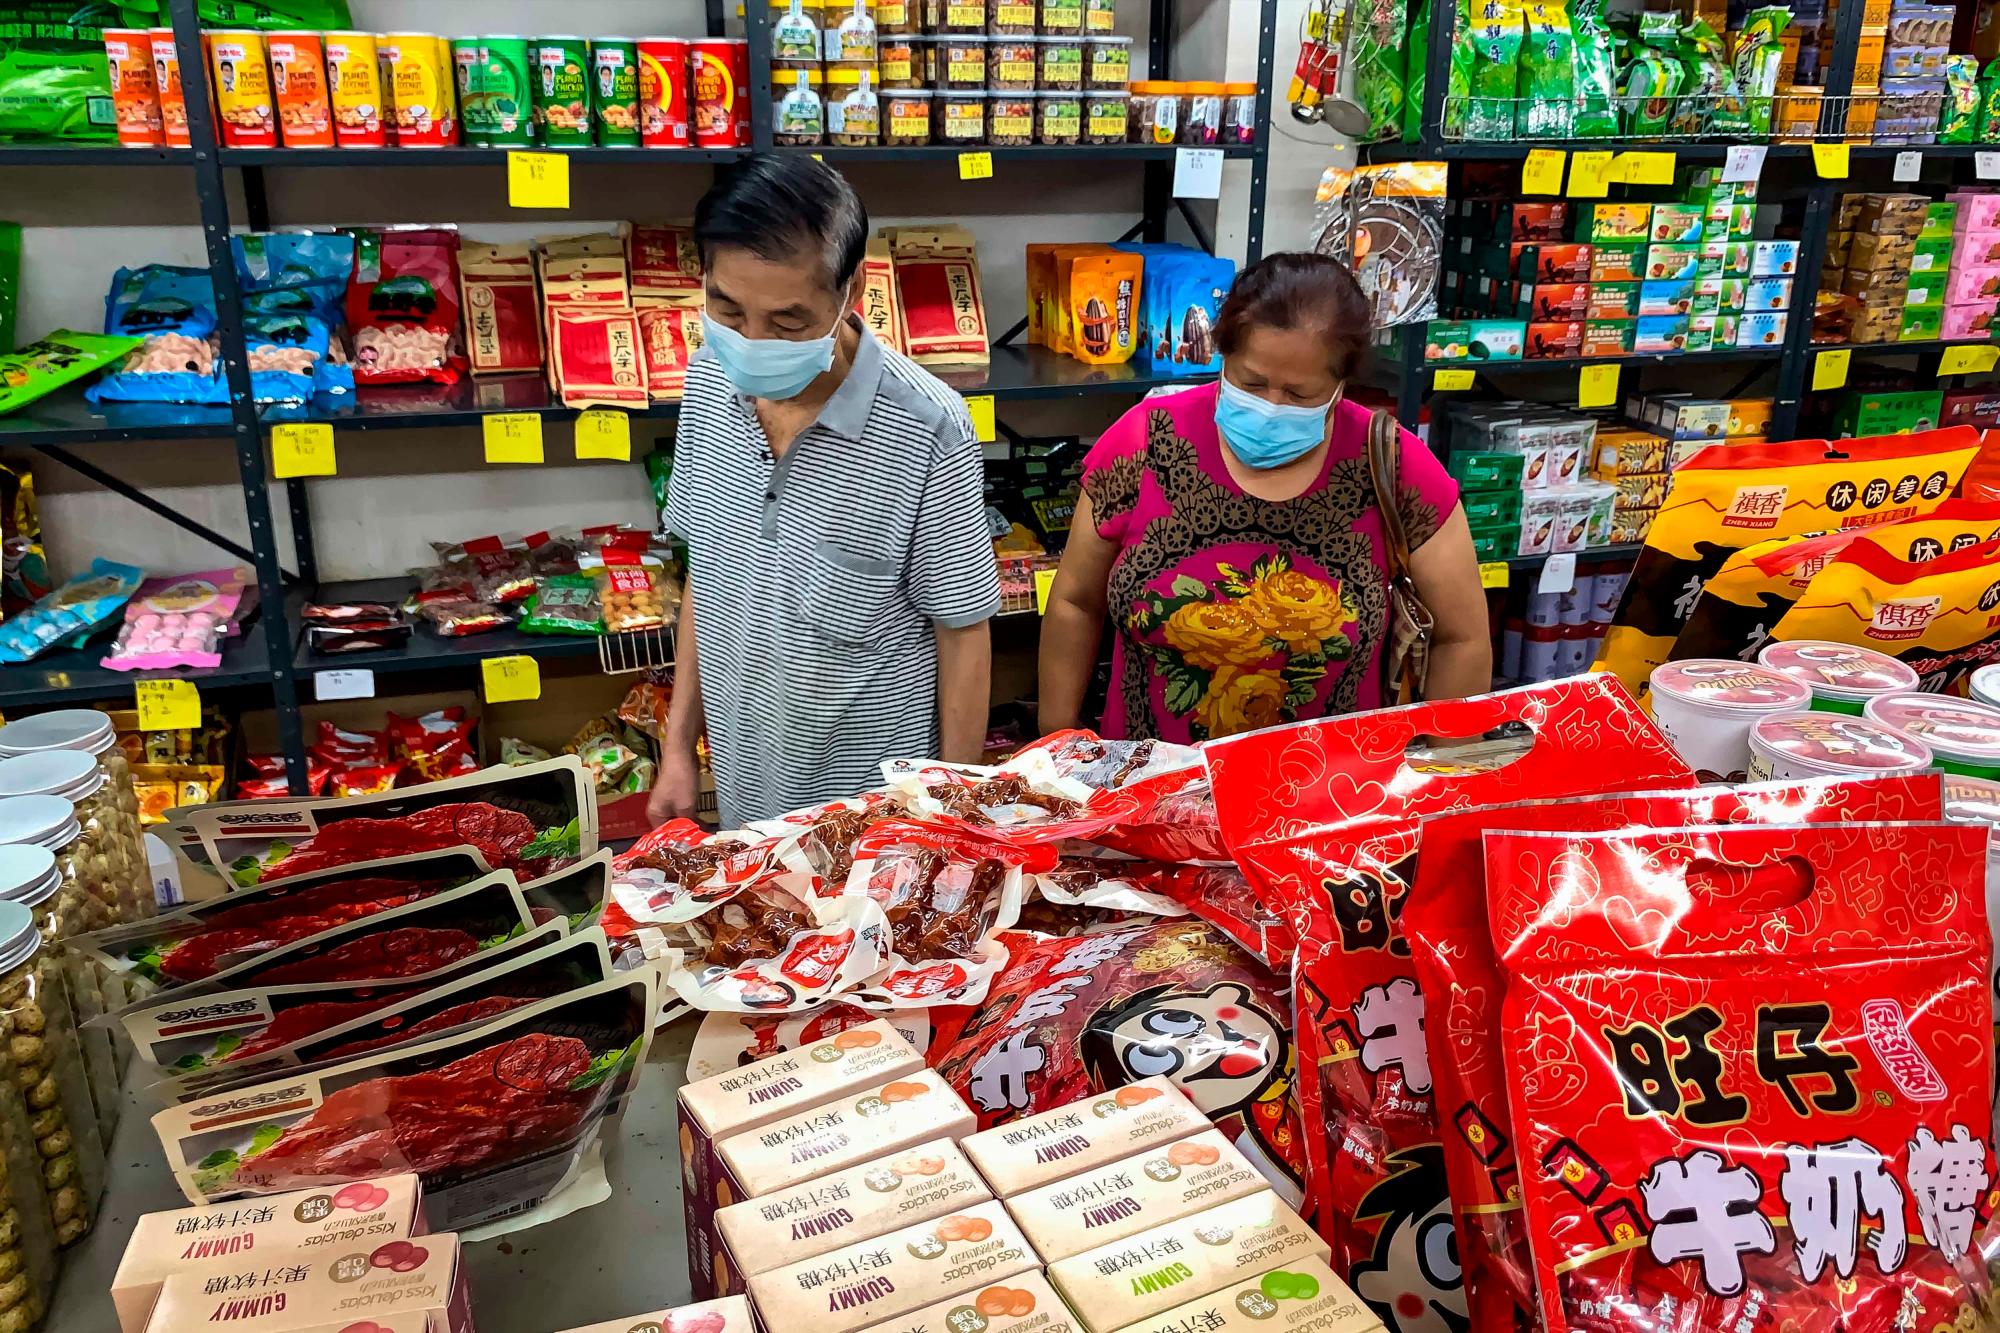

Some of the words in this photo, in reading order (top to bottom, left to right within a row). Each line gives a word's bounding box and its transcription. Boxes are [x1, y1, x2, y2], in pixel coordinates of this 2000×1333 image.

[866, 288, 888, 329] 香瓜子
[952, 274, 973, 313] 香瓜子
[612, 330, 633, 369] 香瓜子
[1831, 474, 1946, 508] 休闲美食
[1725, 519, 1748, 527] ZHEN
[1749, 520, 1775, 528] XIANG
[1869, 631, 1895, 640] ZHEN
[1895, 631, 1921, 640] XIANG
[719, 1057, 800, 1094] 果汁软糖
[1600, 1002, 1864, 1127] 旺仔
[748, 1077, 803, 1105] GUMMY
[759, 1110, 845, 1148] 果汁软糖
[1000, 1112, 1085, 1148] 果汁软糖
[1034, 1133, 1092, 1165] GUMMY
[760, 1182, 852, 1222] 果汁软糖
[1048, 1173, 1135, 1212] 果汁软糖
[1637, 1123, 1989, 1298] 牛奶糖
[174, 1205, 279, 1235] 果汁软糖
[791, 1207, 854, 1241] GUMMY
[1083, 1196, 1142, 1229] GUMMY
[180, 1232, 255, 1260] GUMMY
[1094, 1237, 1185, 1277] 果汁软糖
[202, 1263, 313, 1295] 果汁软糖
[796, 1247, 893, 1291] 果汁软糖
[1131, 1261, 1194, 1297] GUMMY
[208, 1292, 287, 1322] GUMMY
[828, 1275, 896, 1312] GUMMY
